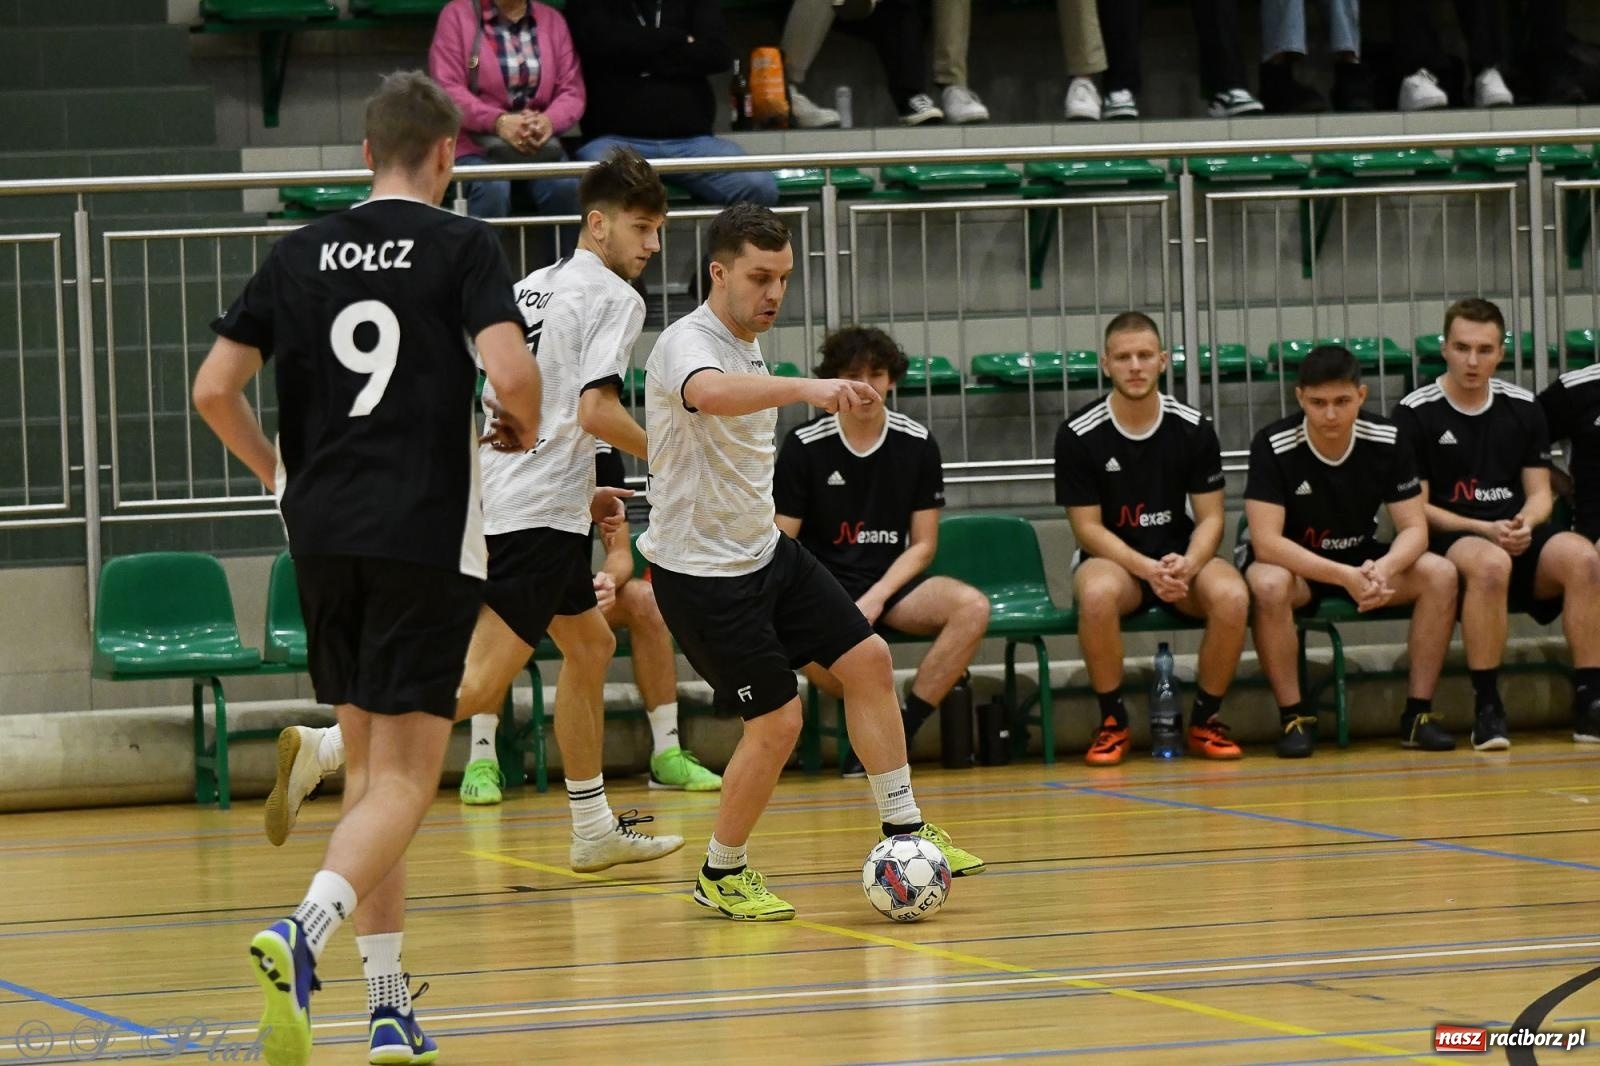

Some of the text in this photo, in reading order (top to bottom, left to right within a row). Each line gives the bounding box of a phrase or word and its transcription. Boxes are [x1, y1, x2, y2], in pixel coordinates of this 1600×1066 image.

[320, 239, 414, 271] KOŁCZ
[330, 299, 401, 418] 9
[1450, 479, 1513, 502] Nexans
[1117, 501, 1172, 528] Nexas
[899, 891, 938, 921] SELECT
